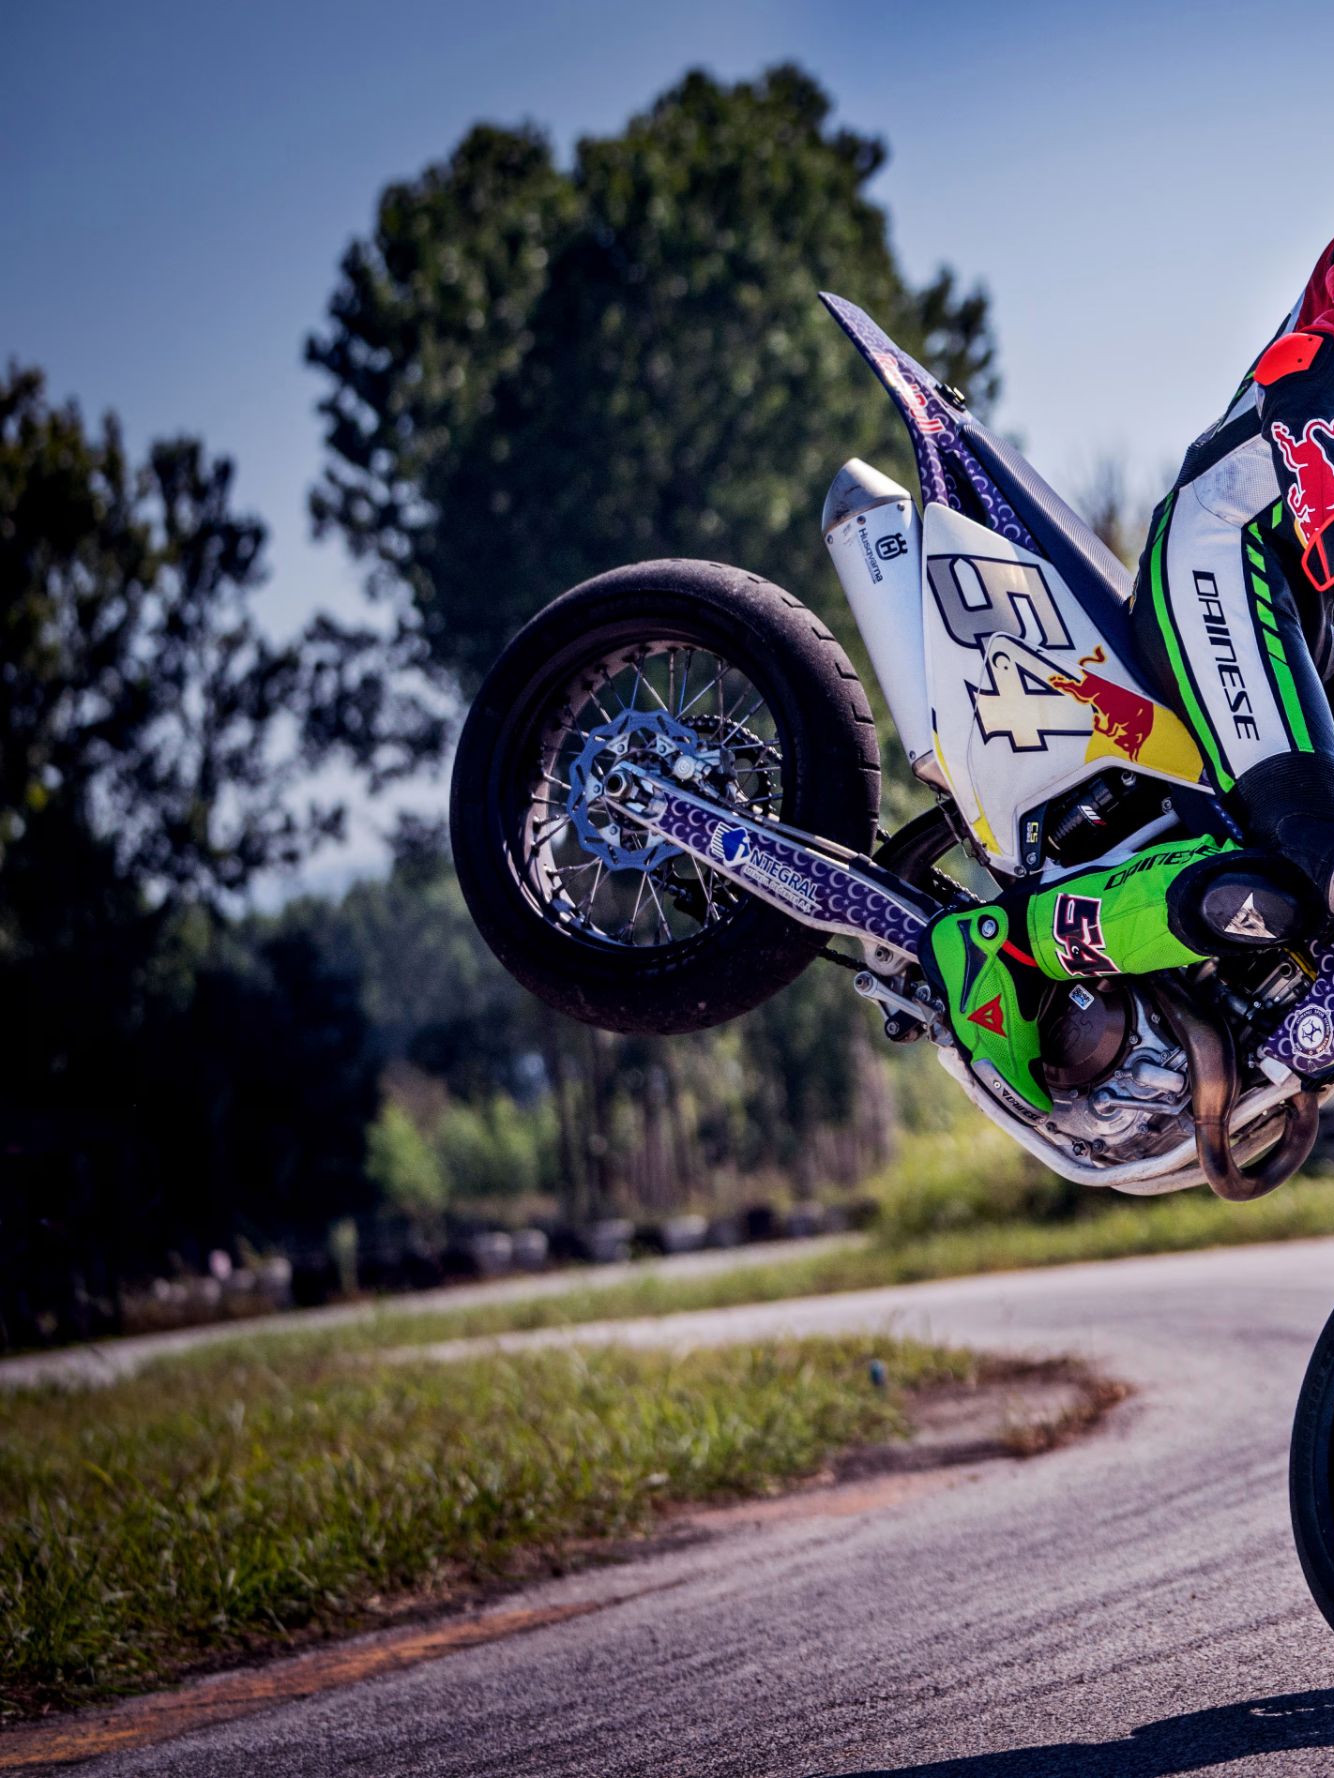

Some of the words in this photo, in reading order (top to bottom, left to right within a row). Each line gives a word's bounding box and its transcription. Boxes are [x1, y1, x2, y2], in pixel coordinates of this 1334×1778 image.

[858, 527, 883, 582] Husqvarna
[926, 553, 1096, 754] 54
[1191, 569, 1260, 741] DAINESE
